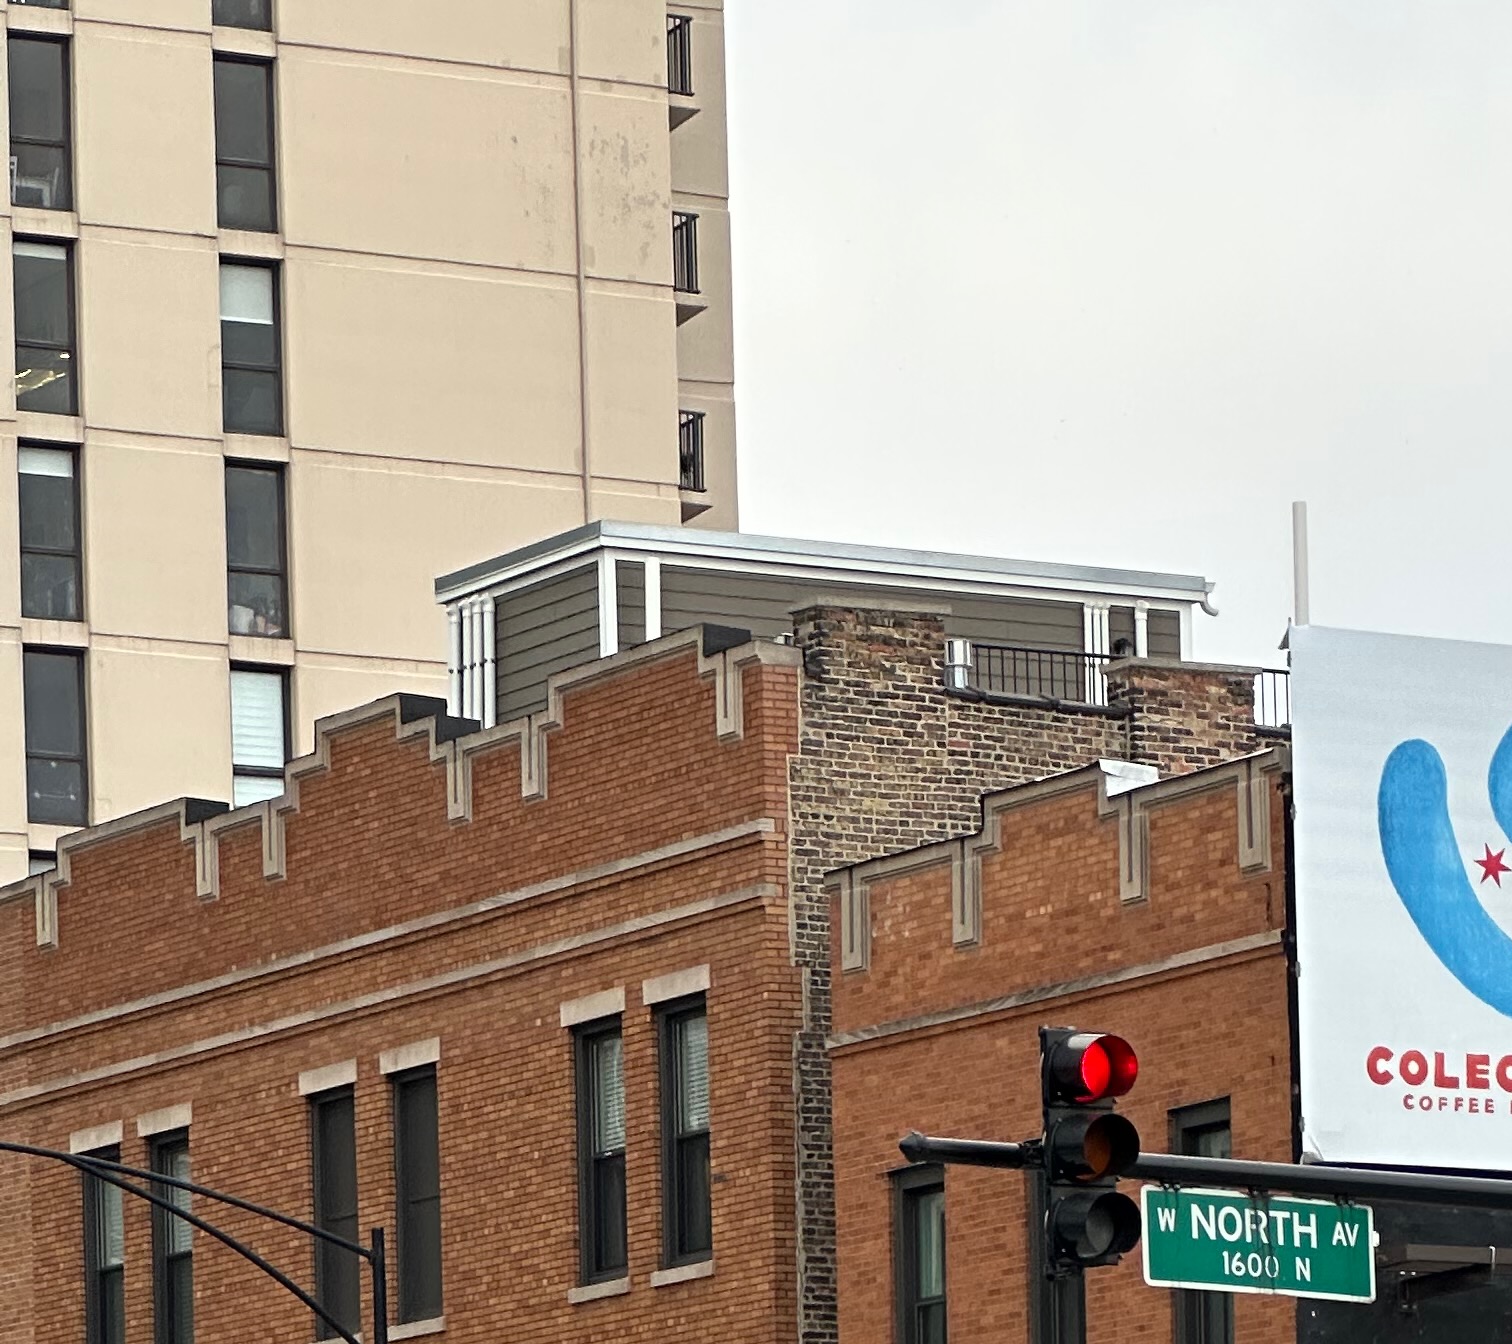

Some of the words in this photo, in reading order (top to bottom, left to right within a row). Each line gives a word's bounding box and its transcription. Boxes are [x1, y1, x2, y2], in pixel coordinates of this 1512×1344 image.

[1403, 1094, 1495, 1114] COFFEE
[1157, 1207, 1176, 1232] W
[1191, 1203, 1318, 1249] NORTH
[1332, 1221, 1360, 1247] AV
[1222, 1250, 1279, 1278] 1600
[1295, 1256, 1311, 1282] N
